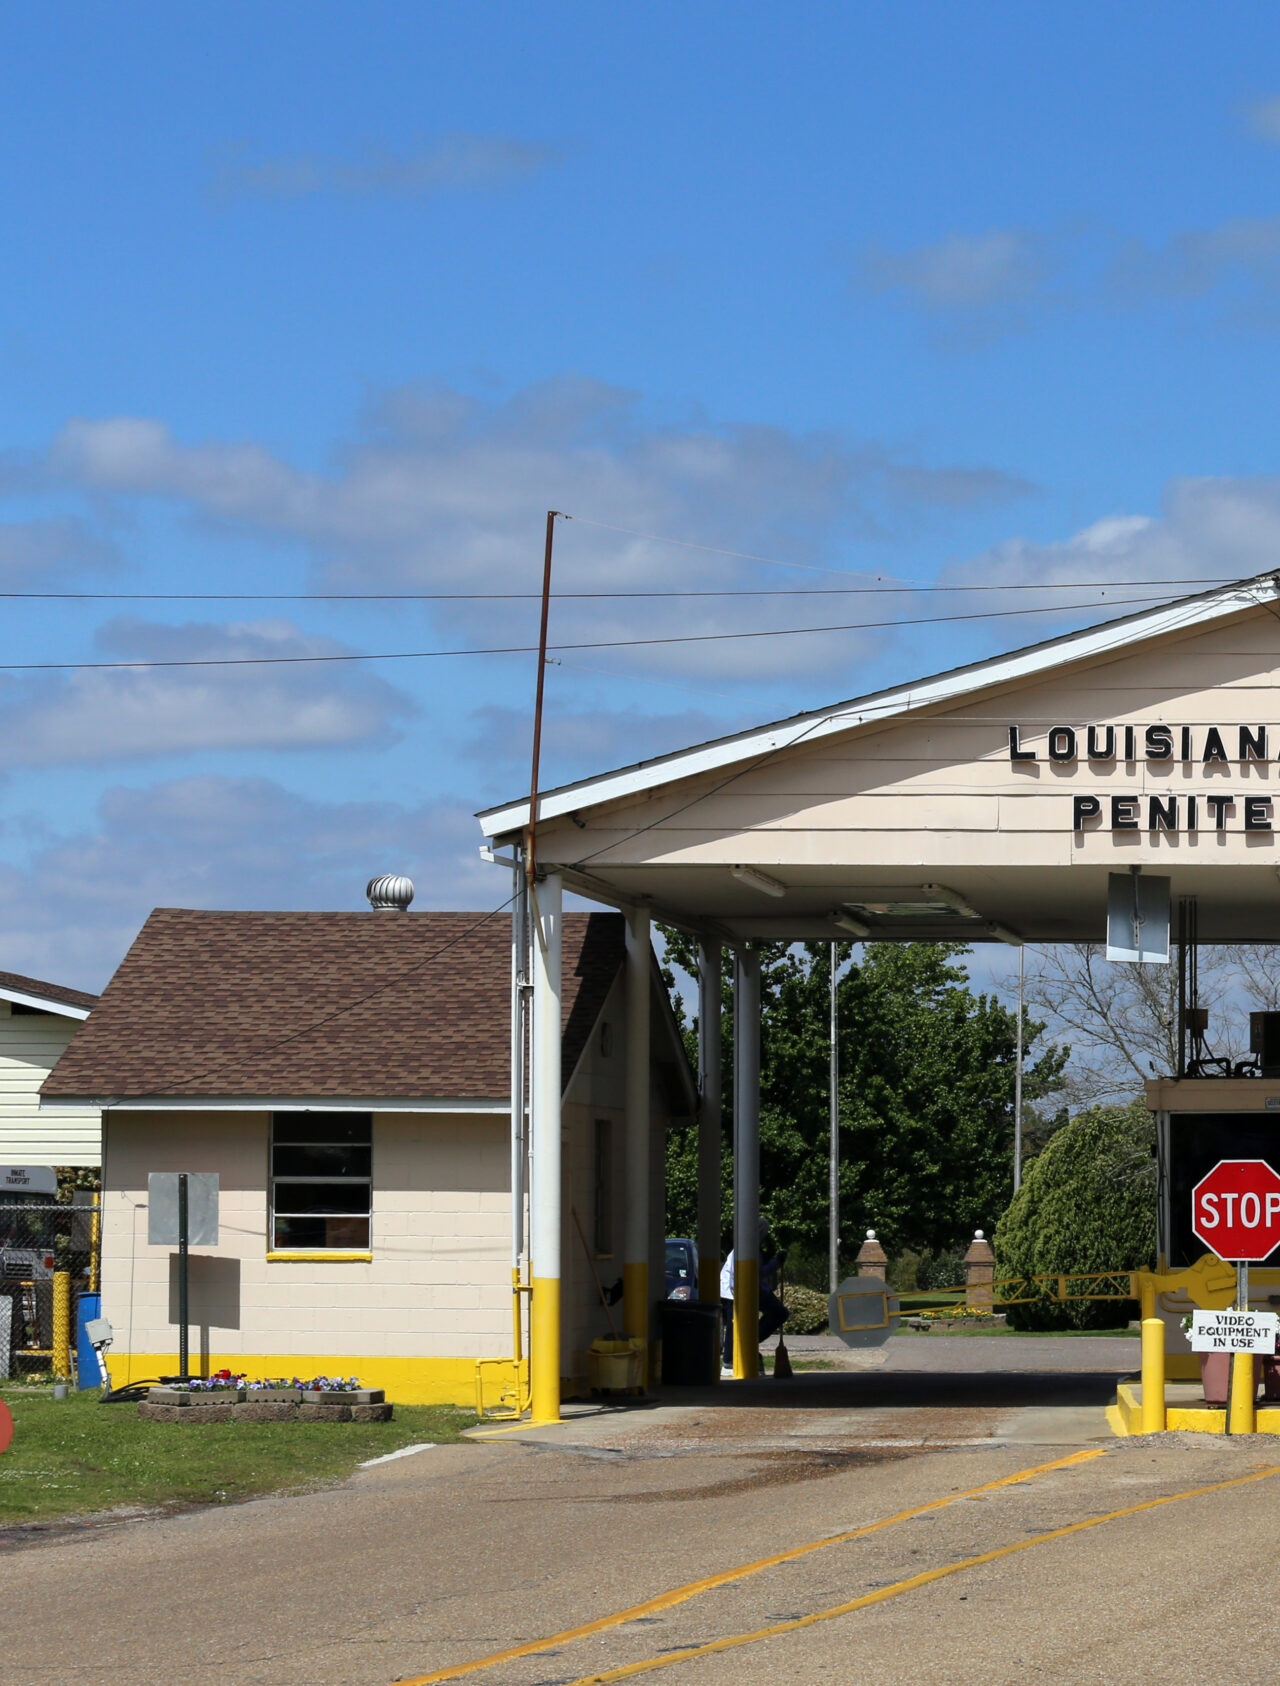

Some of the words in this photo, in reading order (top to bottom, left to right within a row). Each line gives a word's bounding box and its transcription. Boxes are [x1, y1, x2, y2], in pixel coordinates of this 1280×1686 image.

[1215, 1315, 1255, 1326] VIDEO
[1198, 1326, 1271, 1338] EQUIPMENT
[1213, 1337, 1227, 1347] IN
[1231, 1338, 1255, 1349] USE
